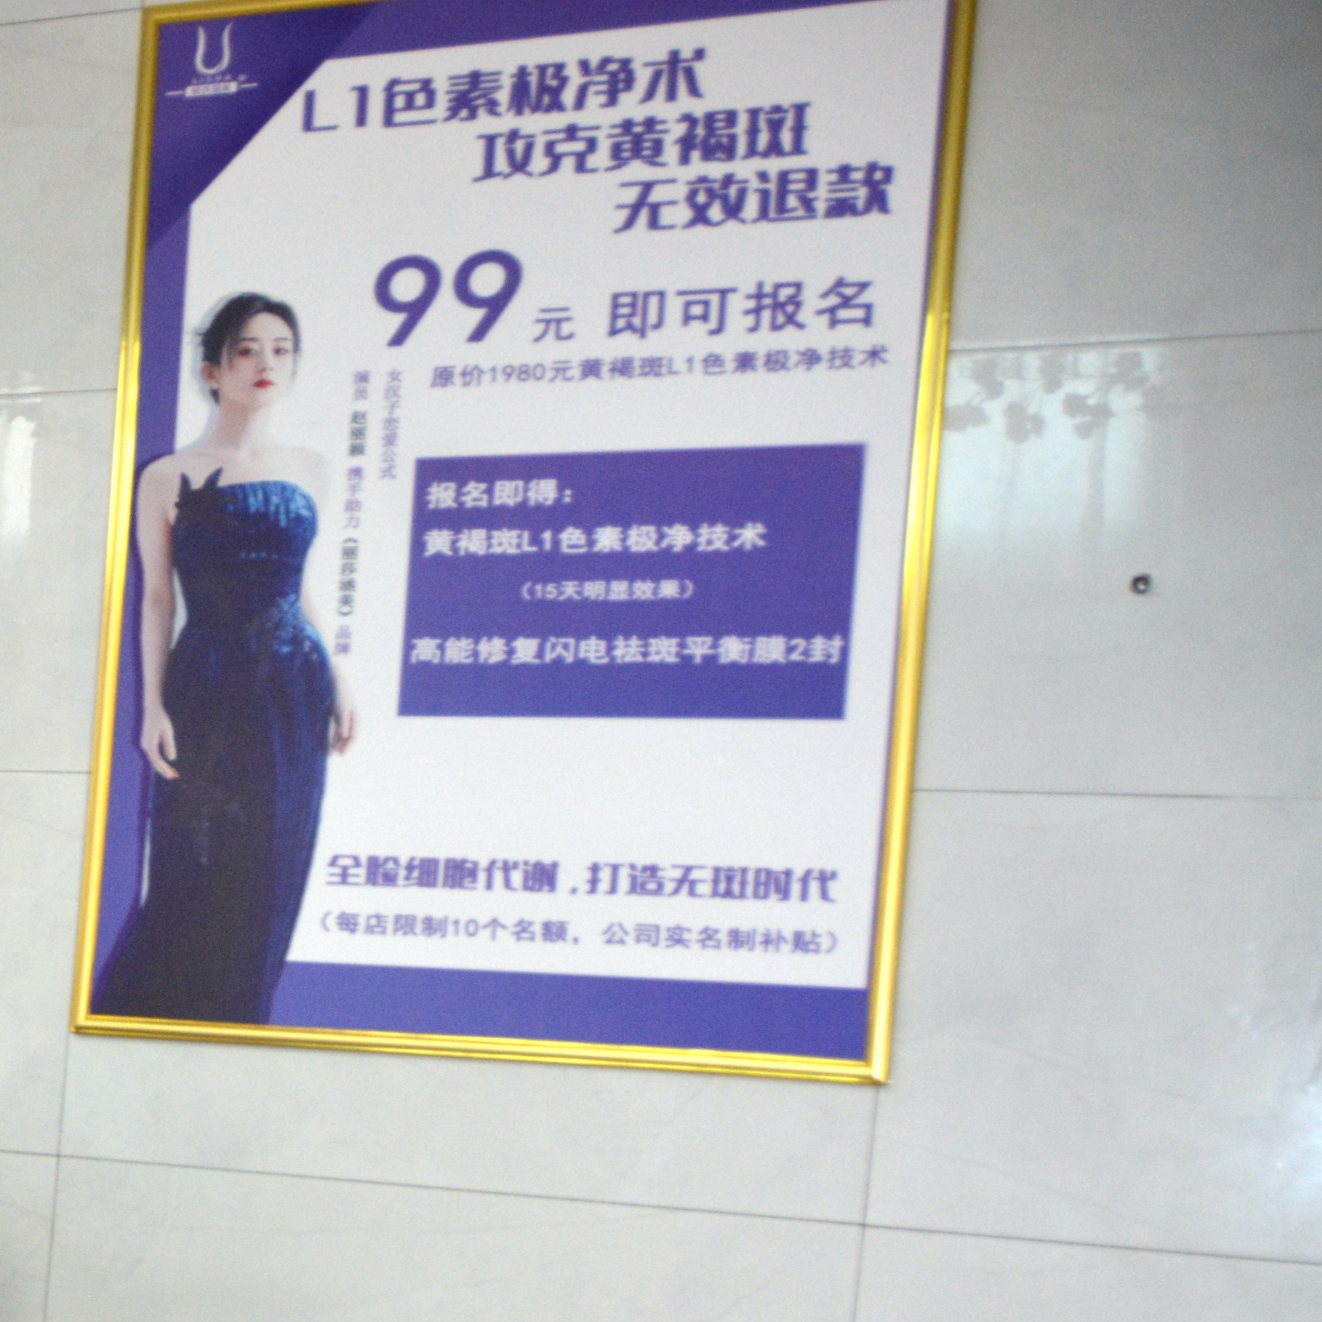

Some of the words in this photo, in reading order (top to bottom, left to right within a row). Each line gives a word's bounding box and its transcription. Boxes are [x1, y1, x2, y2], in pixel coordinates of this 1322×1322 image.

[301, 47, 708, 133] L1色素极净术
[472, 102, 811, 183] 攻克黄褐斑
[613, 161, 895, 234] 无效退款
[607, 275, 876, 340] 即可报名
[429, 344, 890, 390] 原价1980元黄褐斑L1色素极净技术
[423, 523, 768, 557] 黄褐斑L1色素极净技术
[409, 634, 845, 665] 高能修复闪电祛斑平衡膜2封
